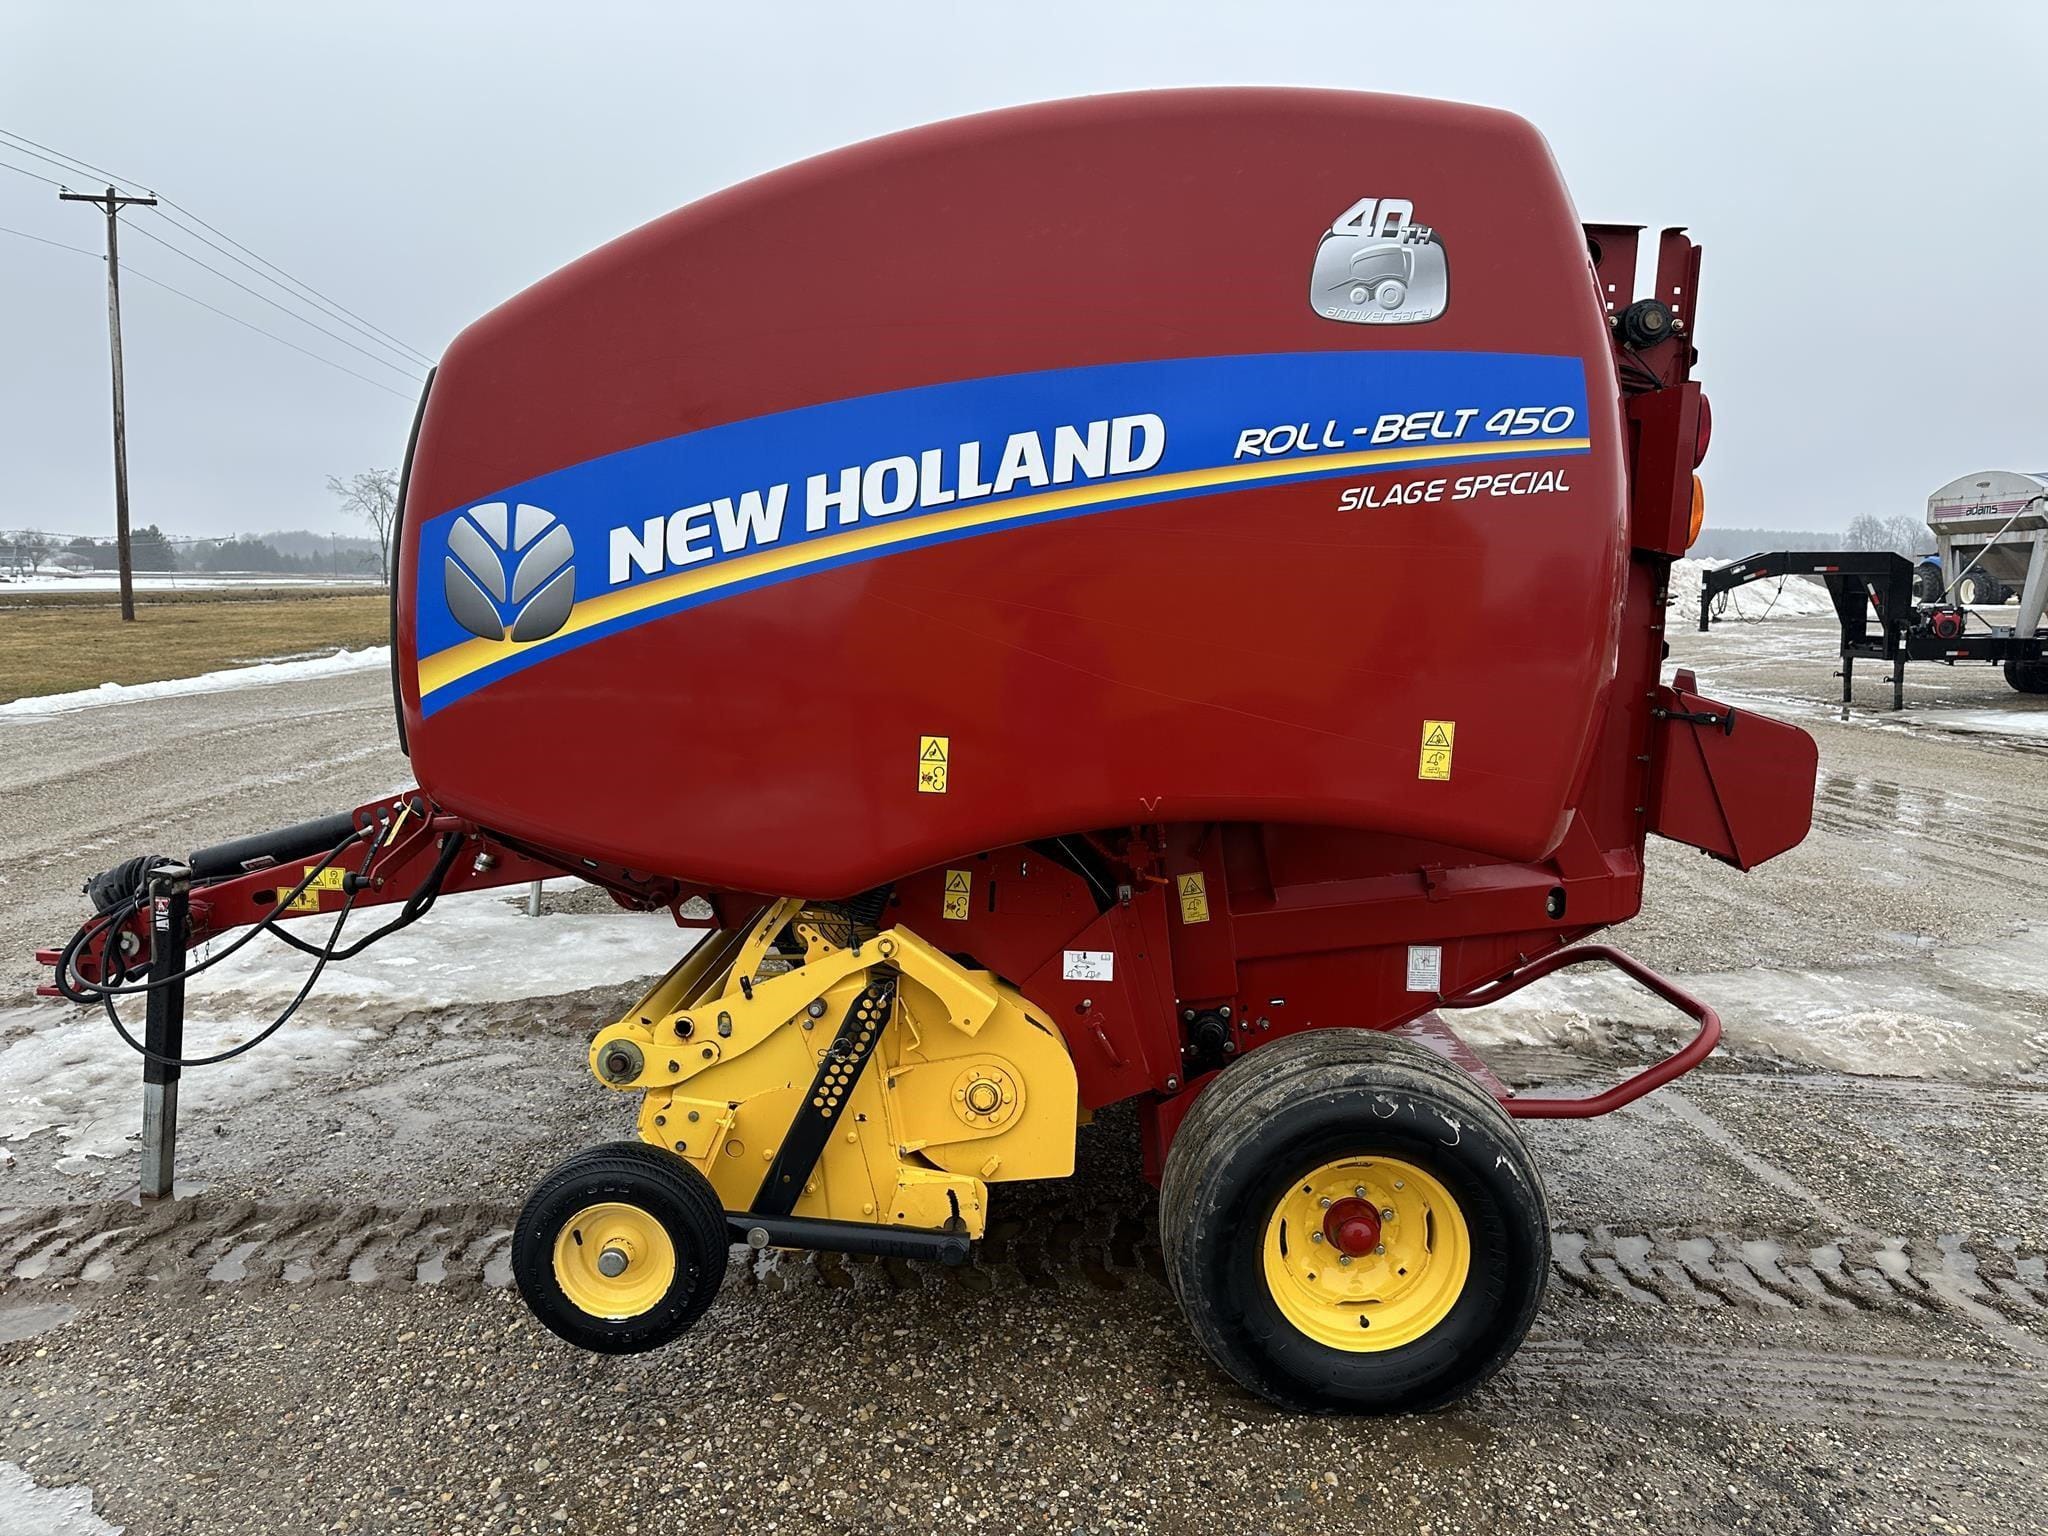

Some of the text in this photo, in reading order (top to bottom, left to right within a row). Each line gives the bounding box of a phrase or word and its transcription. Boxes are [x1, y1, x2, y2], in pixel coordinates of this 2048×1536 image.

[1325, 306, 1433, 322] anniversary
[1486, 406, 1575, 436] 450
[610, 413, 1165, 584] NEW HOLLAND
[1337, 470, 1570, 512] SILAGE SPECIAL
[1966, 503, 1998, 516] adams
